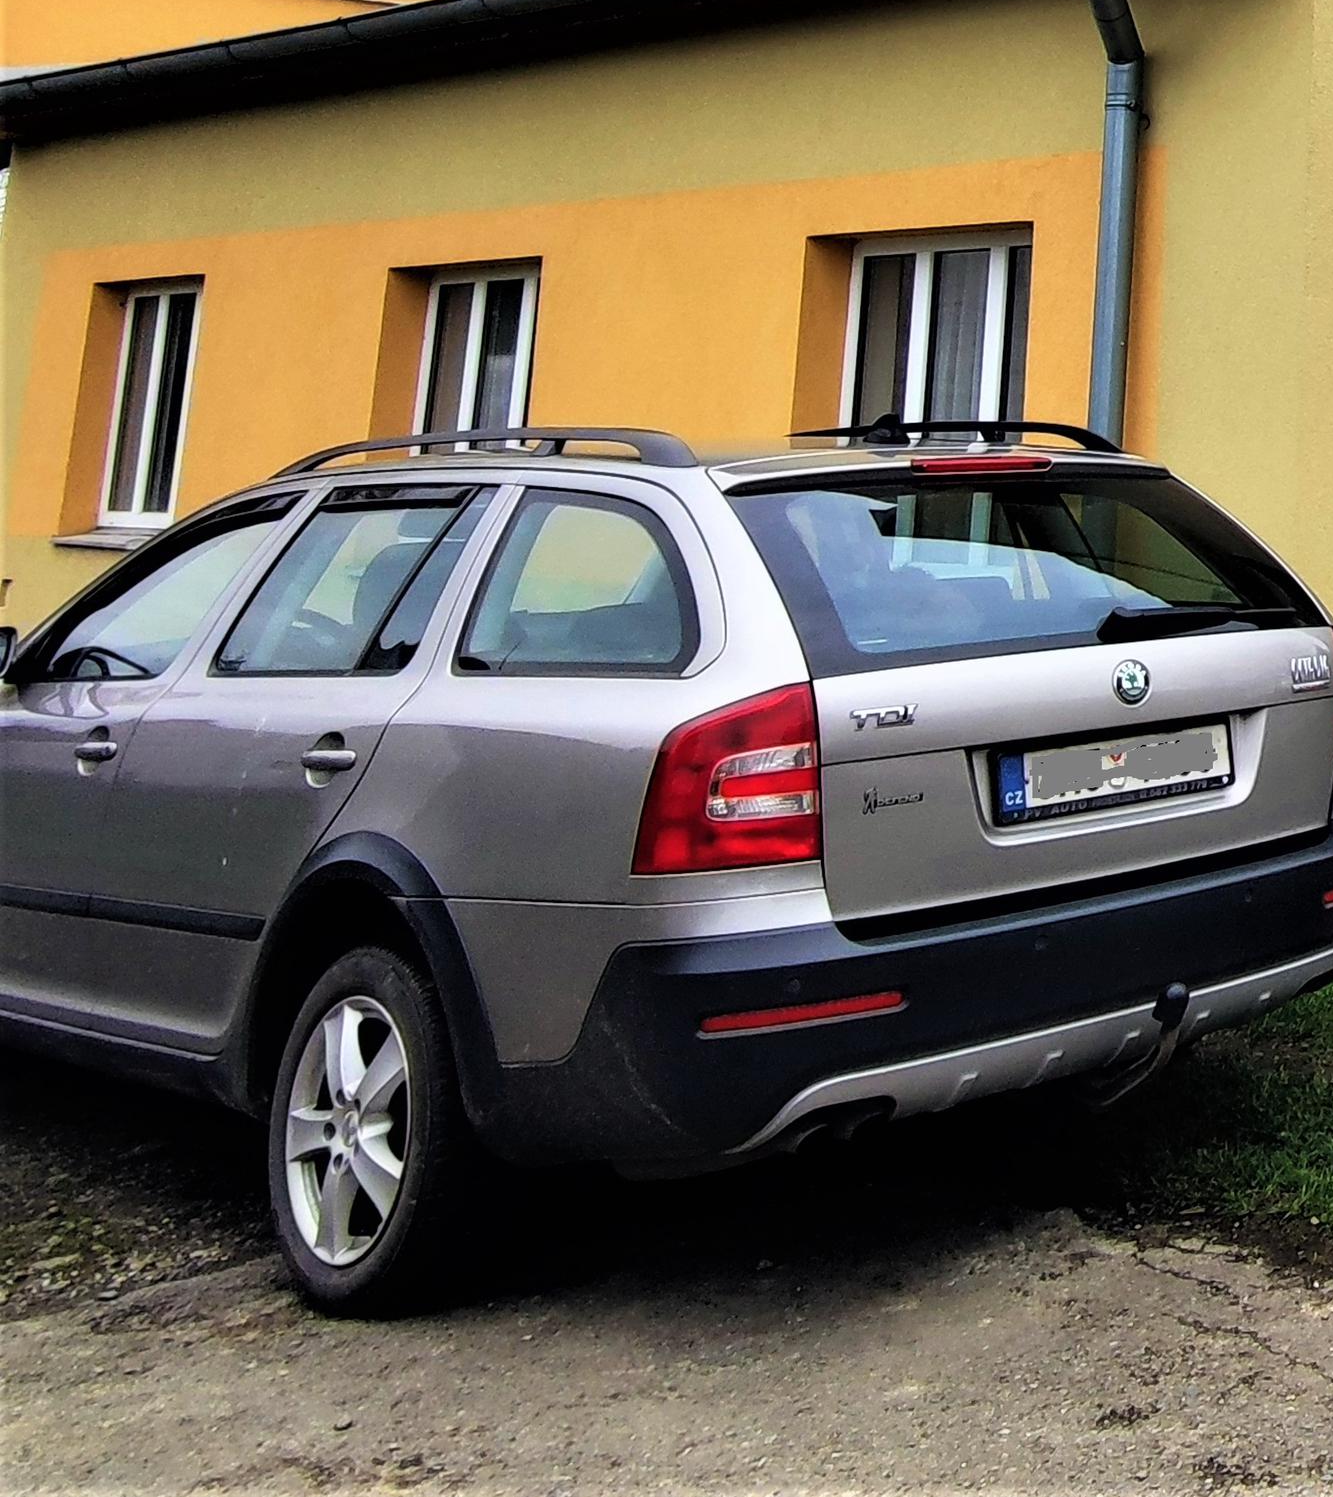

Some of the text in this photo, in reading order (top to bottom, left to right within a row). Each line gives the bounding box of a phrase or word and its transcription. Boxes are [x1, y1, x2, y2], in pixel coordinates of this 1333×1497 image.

[850, 704, 918, 731] TDI
[1004, 789, 1023, 805] CZ
[1051, 801, 1087, 815] AUTO
